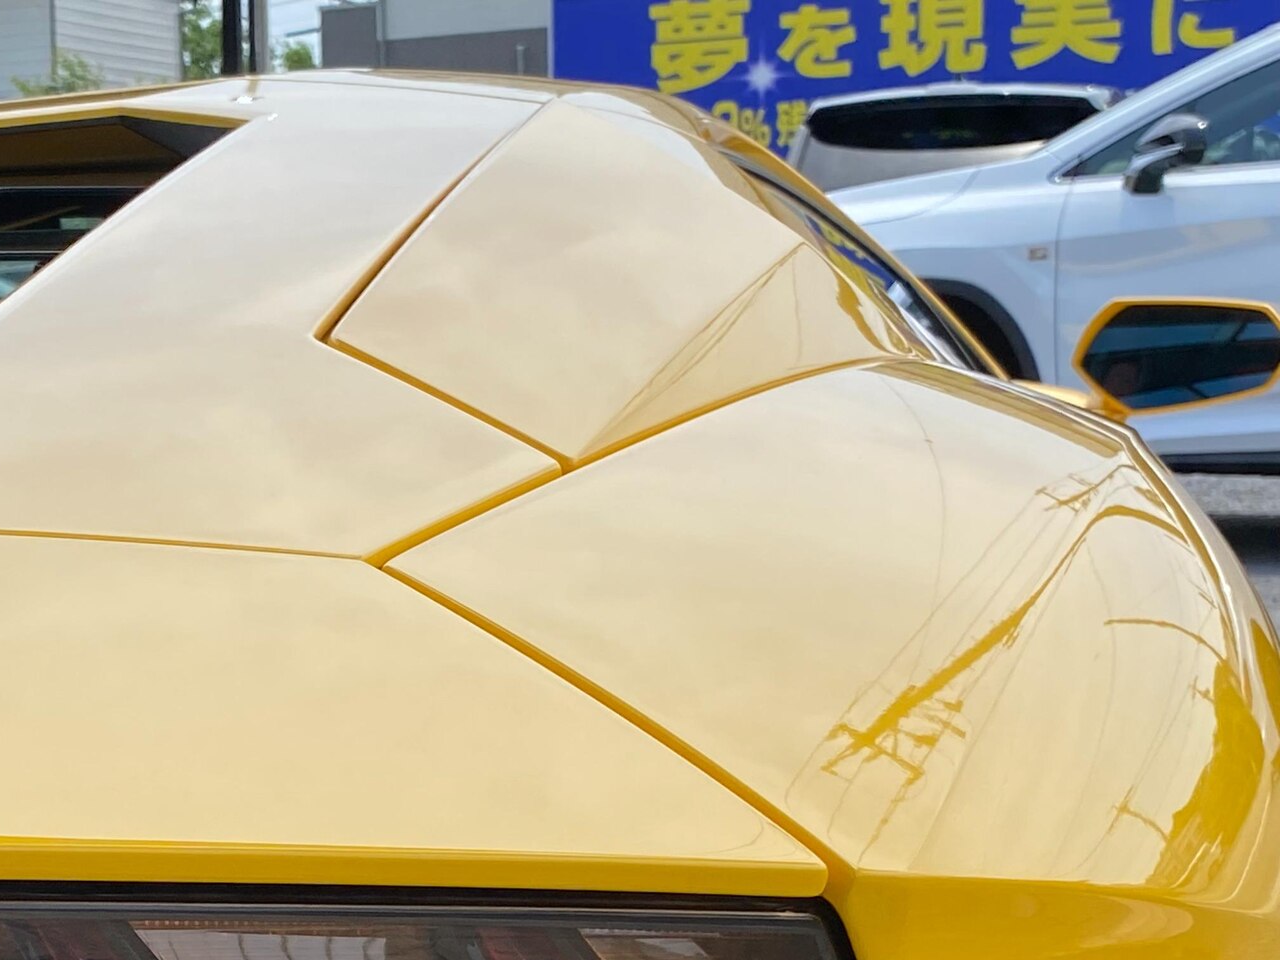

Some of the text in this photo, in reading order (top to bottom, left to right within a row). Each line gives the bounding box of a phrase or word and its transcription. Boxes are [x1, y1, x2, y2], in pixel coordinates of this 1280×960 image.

[648, 0, 1235, 96] 夢を現実に
